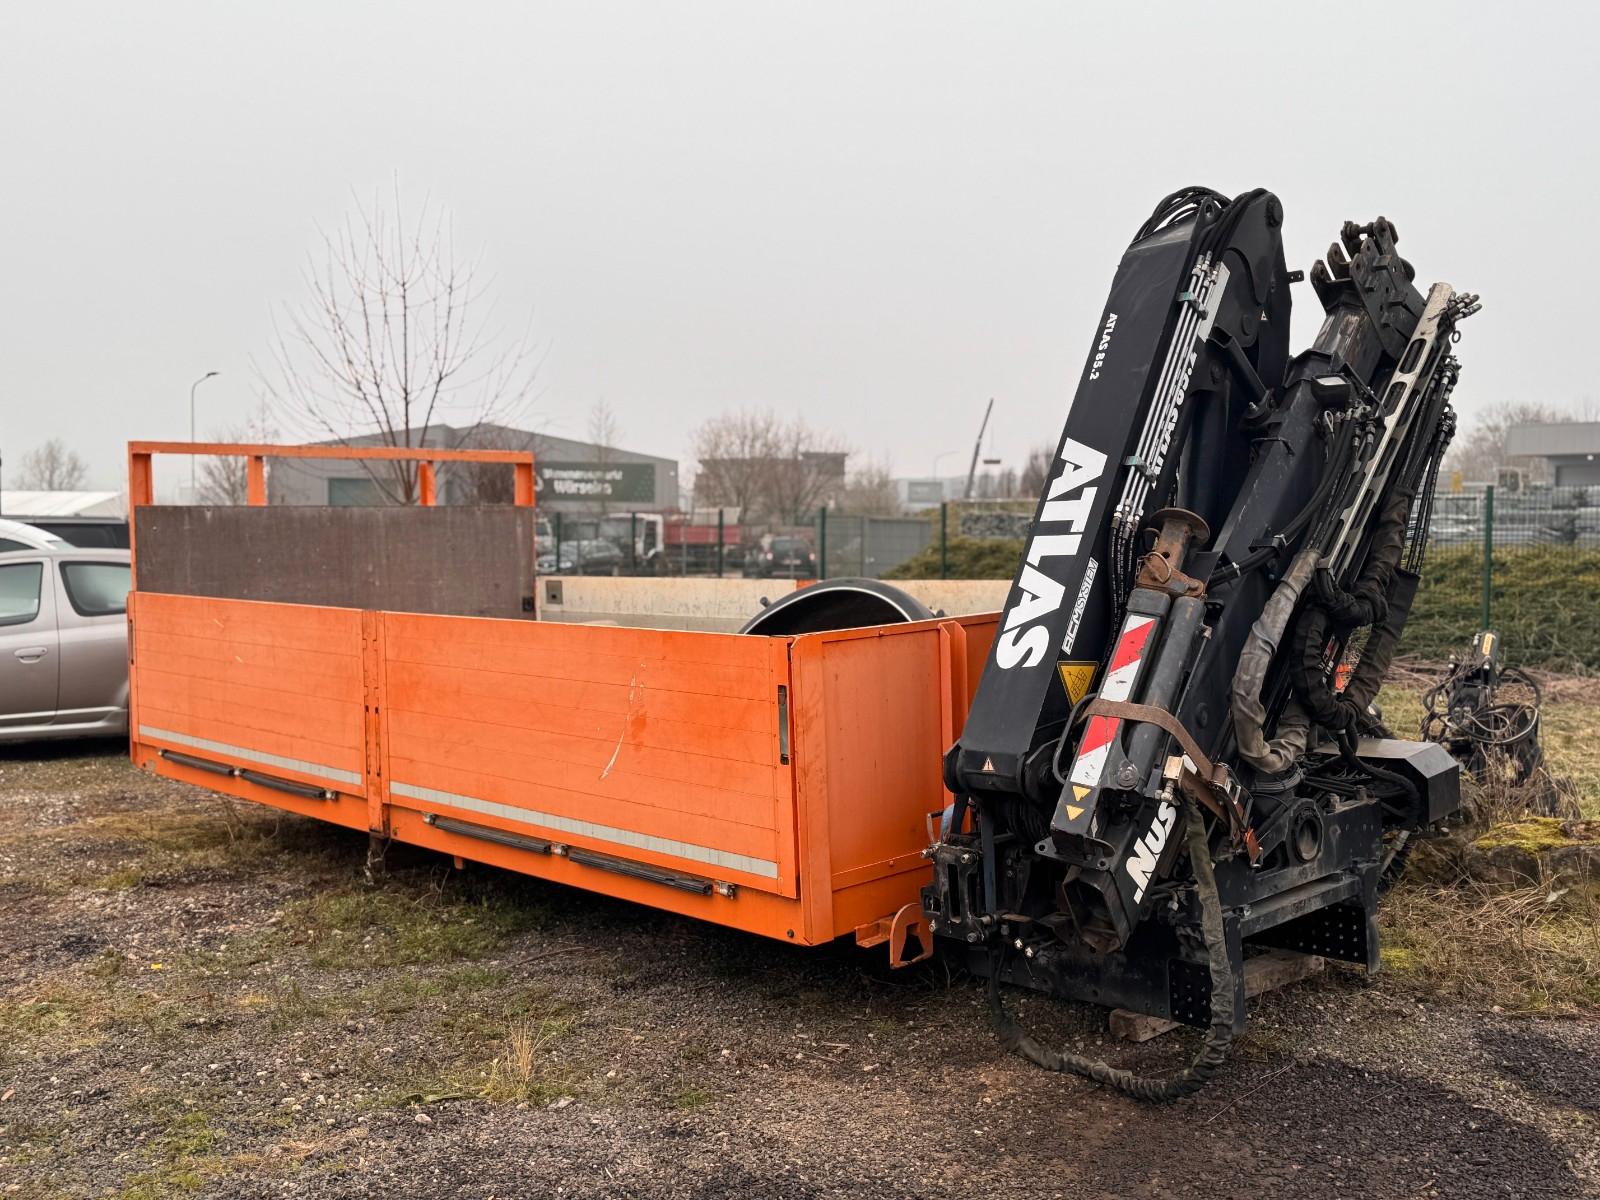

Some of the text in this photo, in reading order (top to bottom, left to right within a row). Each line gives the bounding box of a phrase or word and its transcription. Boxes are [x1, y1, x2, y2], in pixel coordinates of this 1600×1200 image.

[1089, 312, 1118, 381] ATLAS 85.2
[996, 437, 1108, 669] ATLAS
